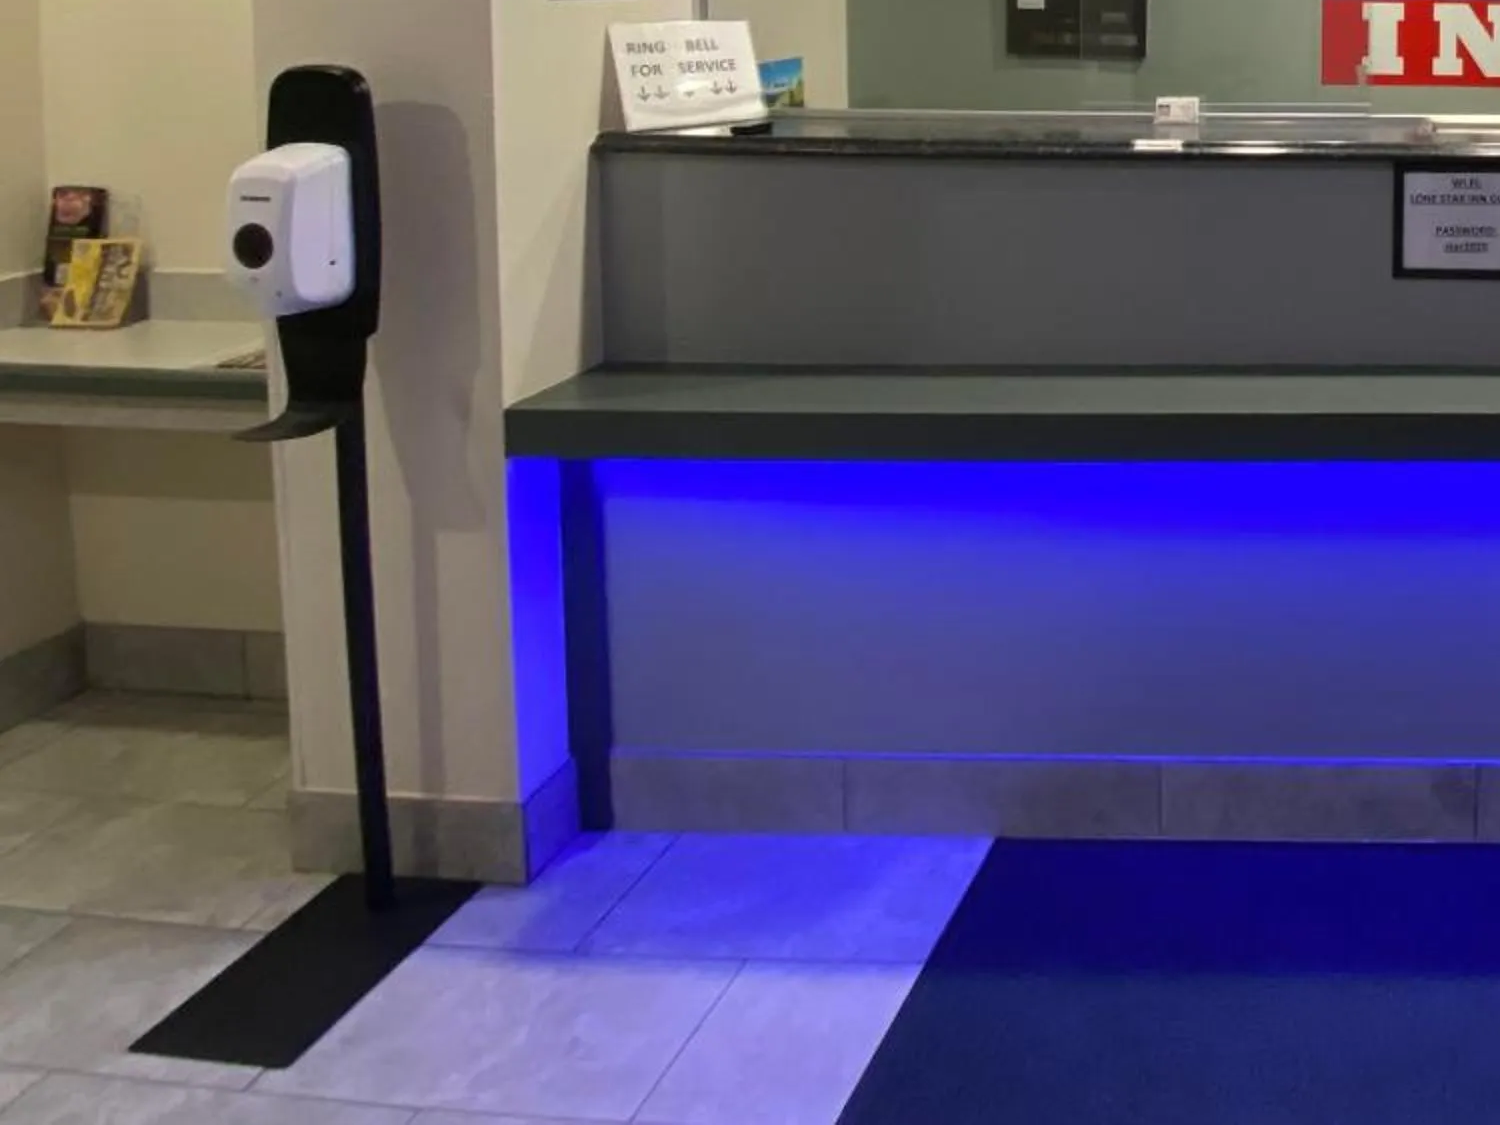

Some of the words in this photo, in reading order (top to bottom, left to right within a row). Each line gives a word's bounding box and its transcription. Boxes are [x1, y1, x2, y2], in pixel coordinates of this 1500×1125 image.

[625, 40, 667, 56] RING
[684, 37, 719, 54] BELL
[631, 63, 663, 78] FOR
[677, 57, 738, 75] SERVICE
